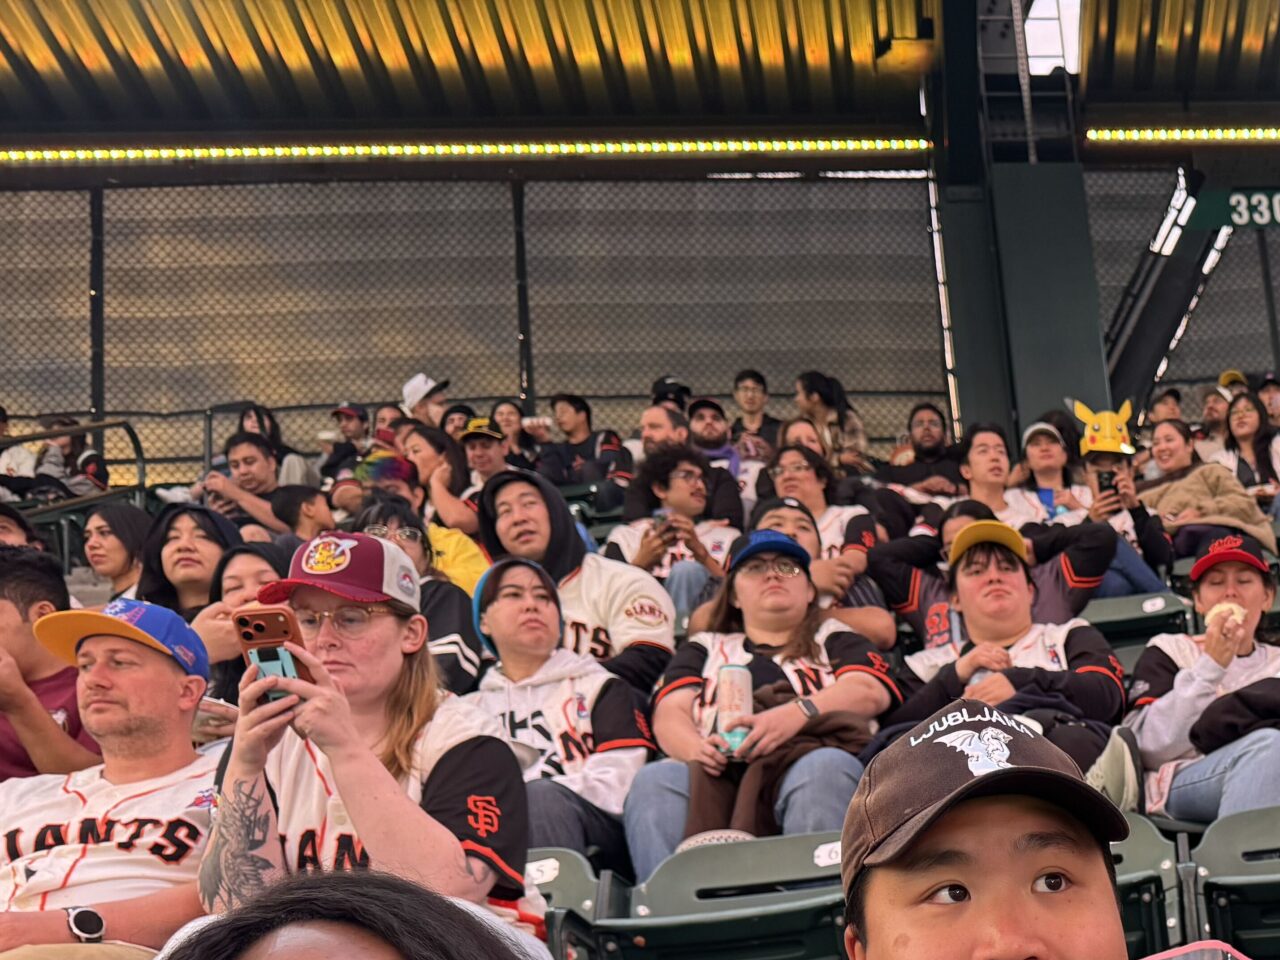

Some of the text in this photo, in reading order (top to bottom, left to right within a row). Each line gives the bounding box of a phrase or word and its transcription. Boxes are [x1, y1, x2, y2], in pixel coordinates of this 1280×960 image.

[909, 706, 1035, 747] LJUBLJANA
[467, 794, 501, 838] SF
[3, 817, 201, 864] IANTS
[828, 846, 838, 860] 6
[535, 864, 545, 879] 5
